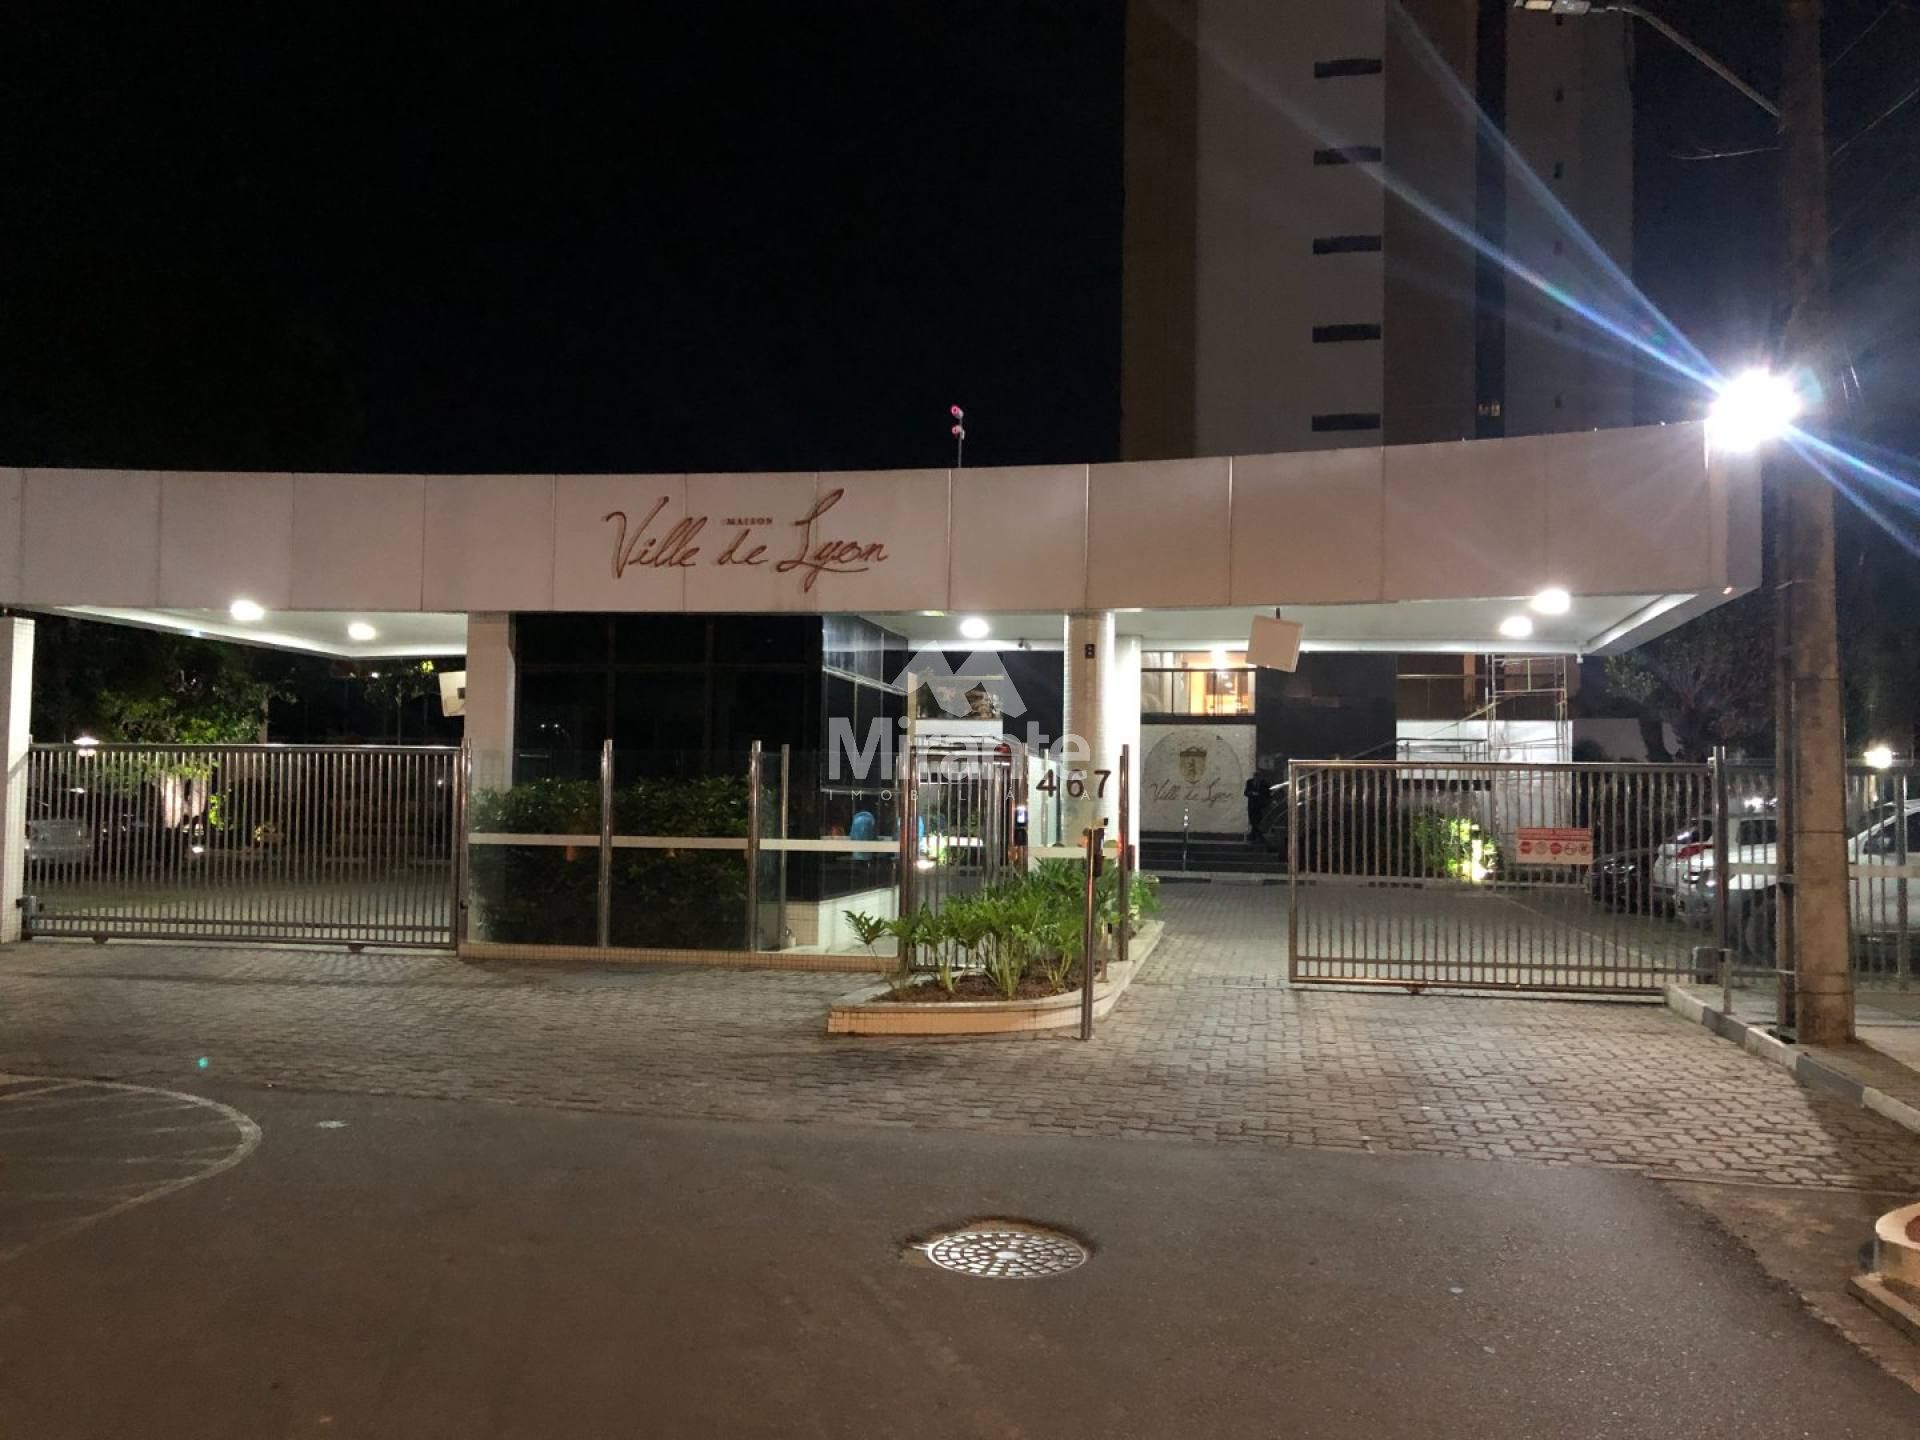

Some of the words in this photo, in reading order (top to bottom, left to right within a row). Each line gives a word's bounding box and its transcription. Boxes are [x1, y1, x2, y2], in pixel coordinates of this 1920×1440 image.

[727, 517, 773, 526] MAISON
[605, 496, 708, 578] Ville
[716, 529, 768, 565] de
[776, 488, 888, 592] Lyon
[1035, 769, 1112, 798] 467
